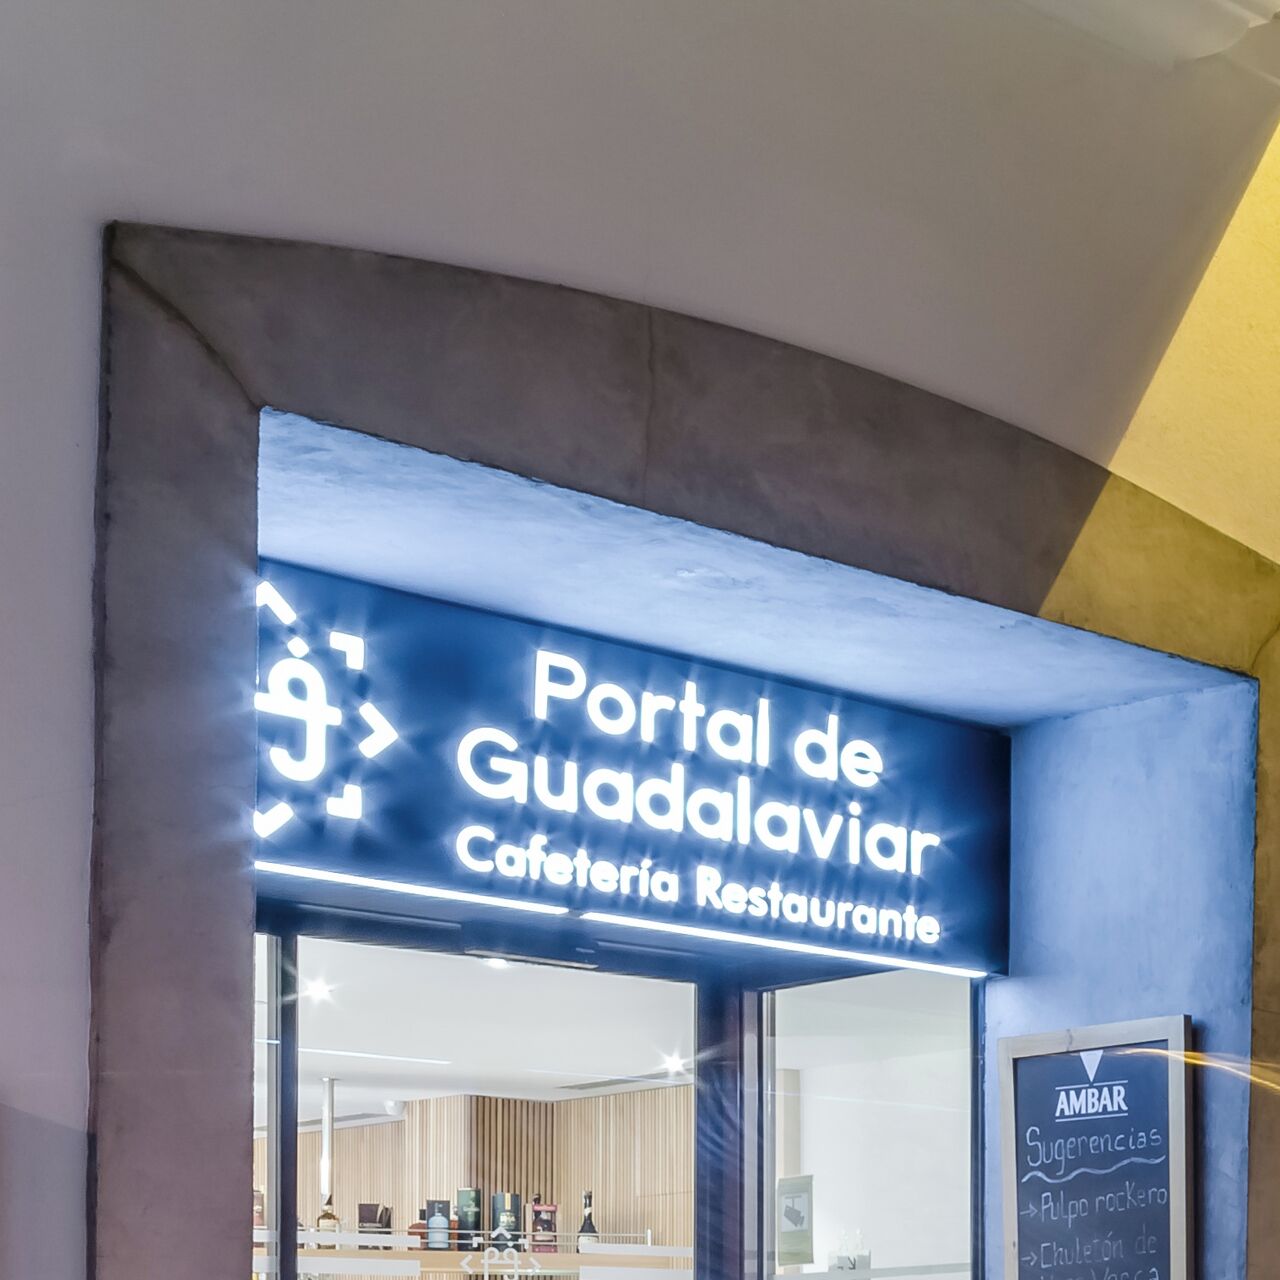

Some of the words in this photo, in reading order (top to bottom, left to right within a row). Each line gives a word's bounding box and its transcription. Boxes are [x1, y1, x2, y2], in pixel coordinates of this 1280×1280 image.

[534, 649, 770, 766] Portal
[793, 713, 884, 788] de
[457, 727, 941, 876] Guadalaviar
[455, 825, 680, 902] Cafetería
[696, 864, 941, 944] Restaurante
[1055, 1085, 1128, 1117] AMBAR
[1026, 1126, 1162, 1175] Sugerencias
[1041, 1190, 1088, 1228] Pulpo
[1095, 1181, 1167, 1212] rockero
[1040, 1231, 1124, 1269] Chuletón
[1135, 1224, 1157, 1254] de
